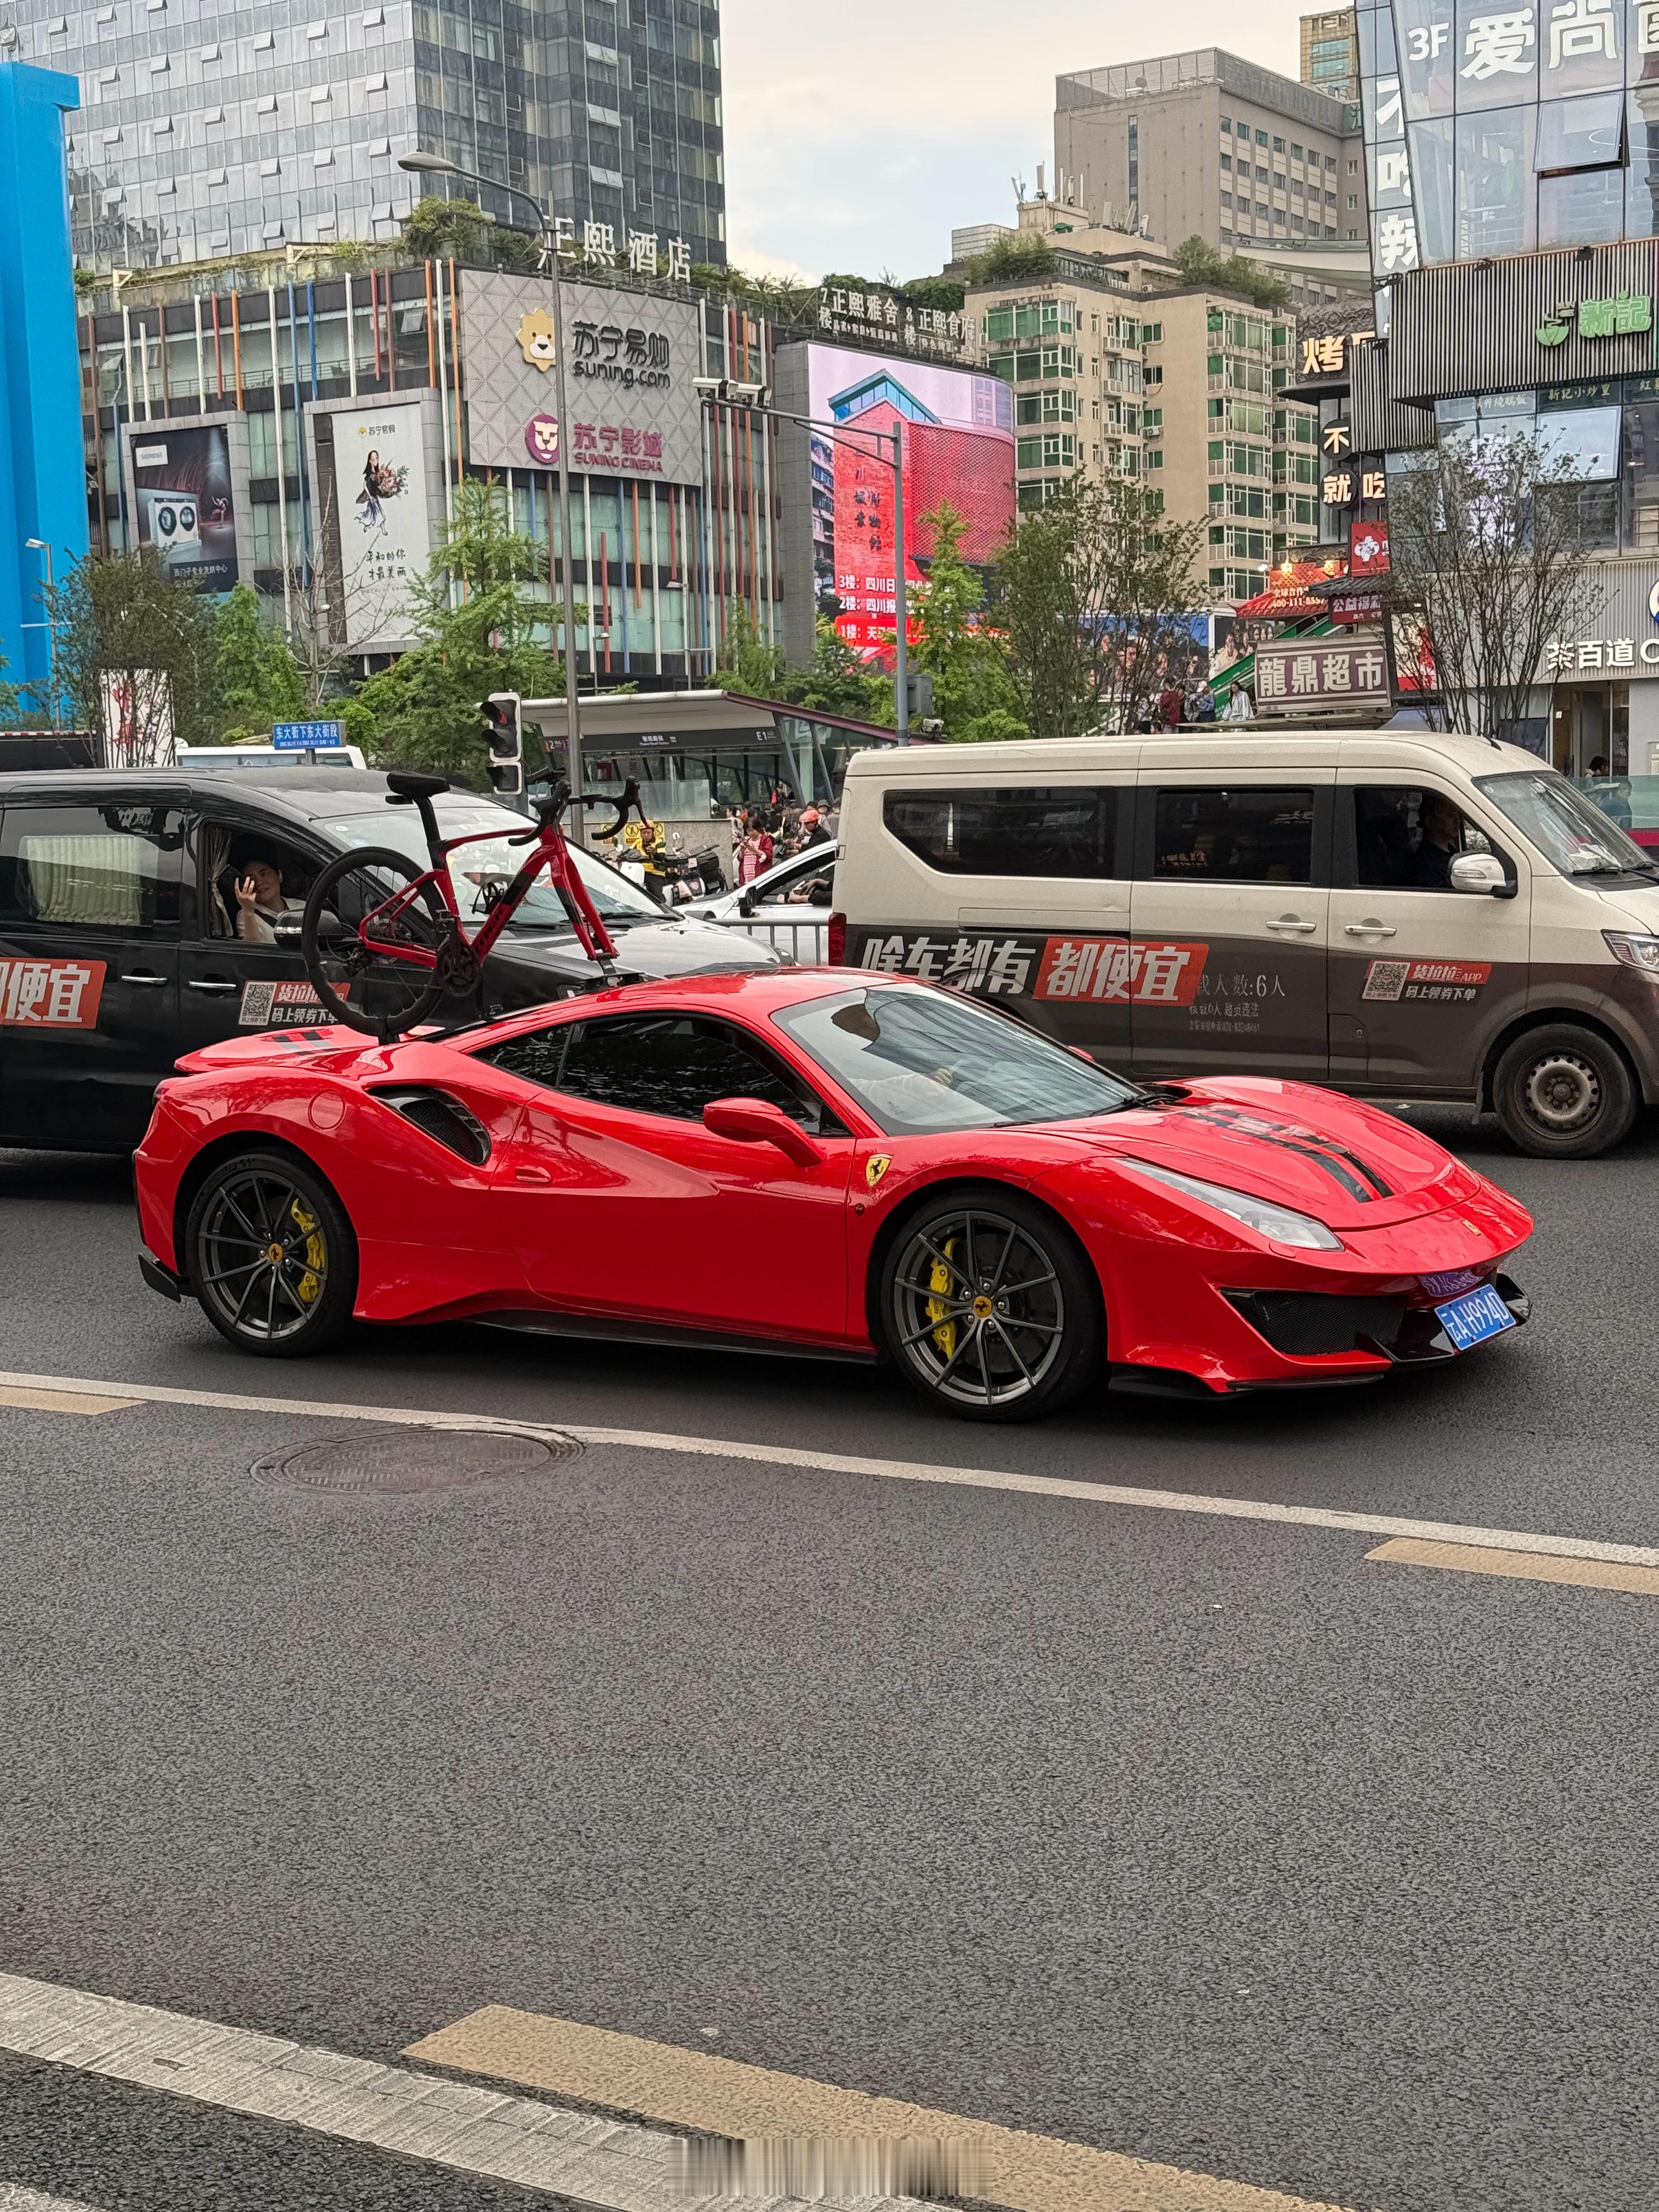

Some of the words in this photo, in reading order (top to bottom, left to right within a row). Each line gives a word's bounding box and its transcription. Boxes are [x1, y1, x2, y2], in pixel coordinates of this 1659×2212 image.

[1408, 22, 1449, 61] 3F
[831, 287, 898, 325] 正熙雅舍
[572, 320, 669, 370] 苏宁易购
[573, 361, 670, 389] suning.com
[574, 452, 619, 467] SUNING
[621, 457, 663, 473] CINEMA
[1259, 652, 1383, 697] 龍鼎超市
[756, 731, 767, 741] E1
[1047, 942, 1191, 1001] 都便宜
